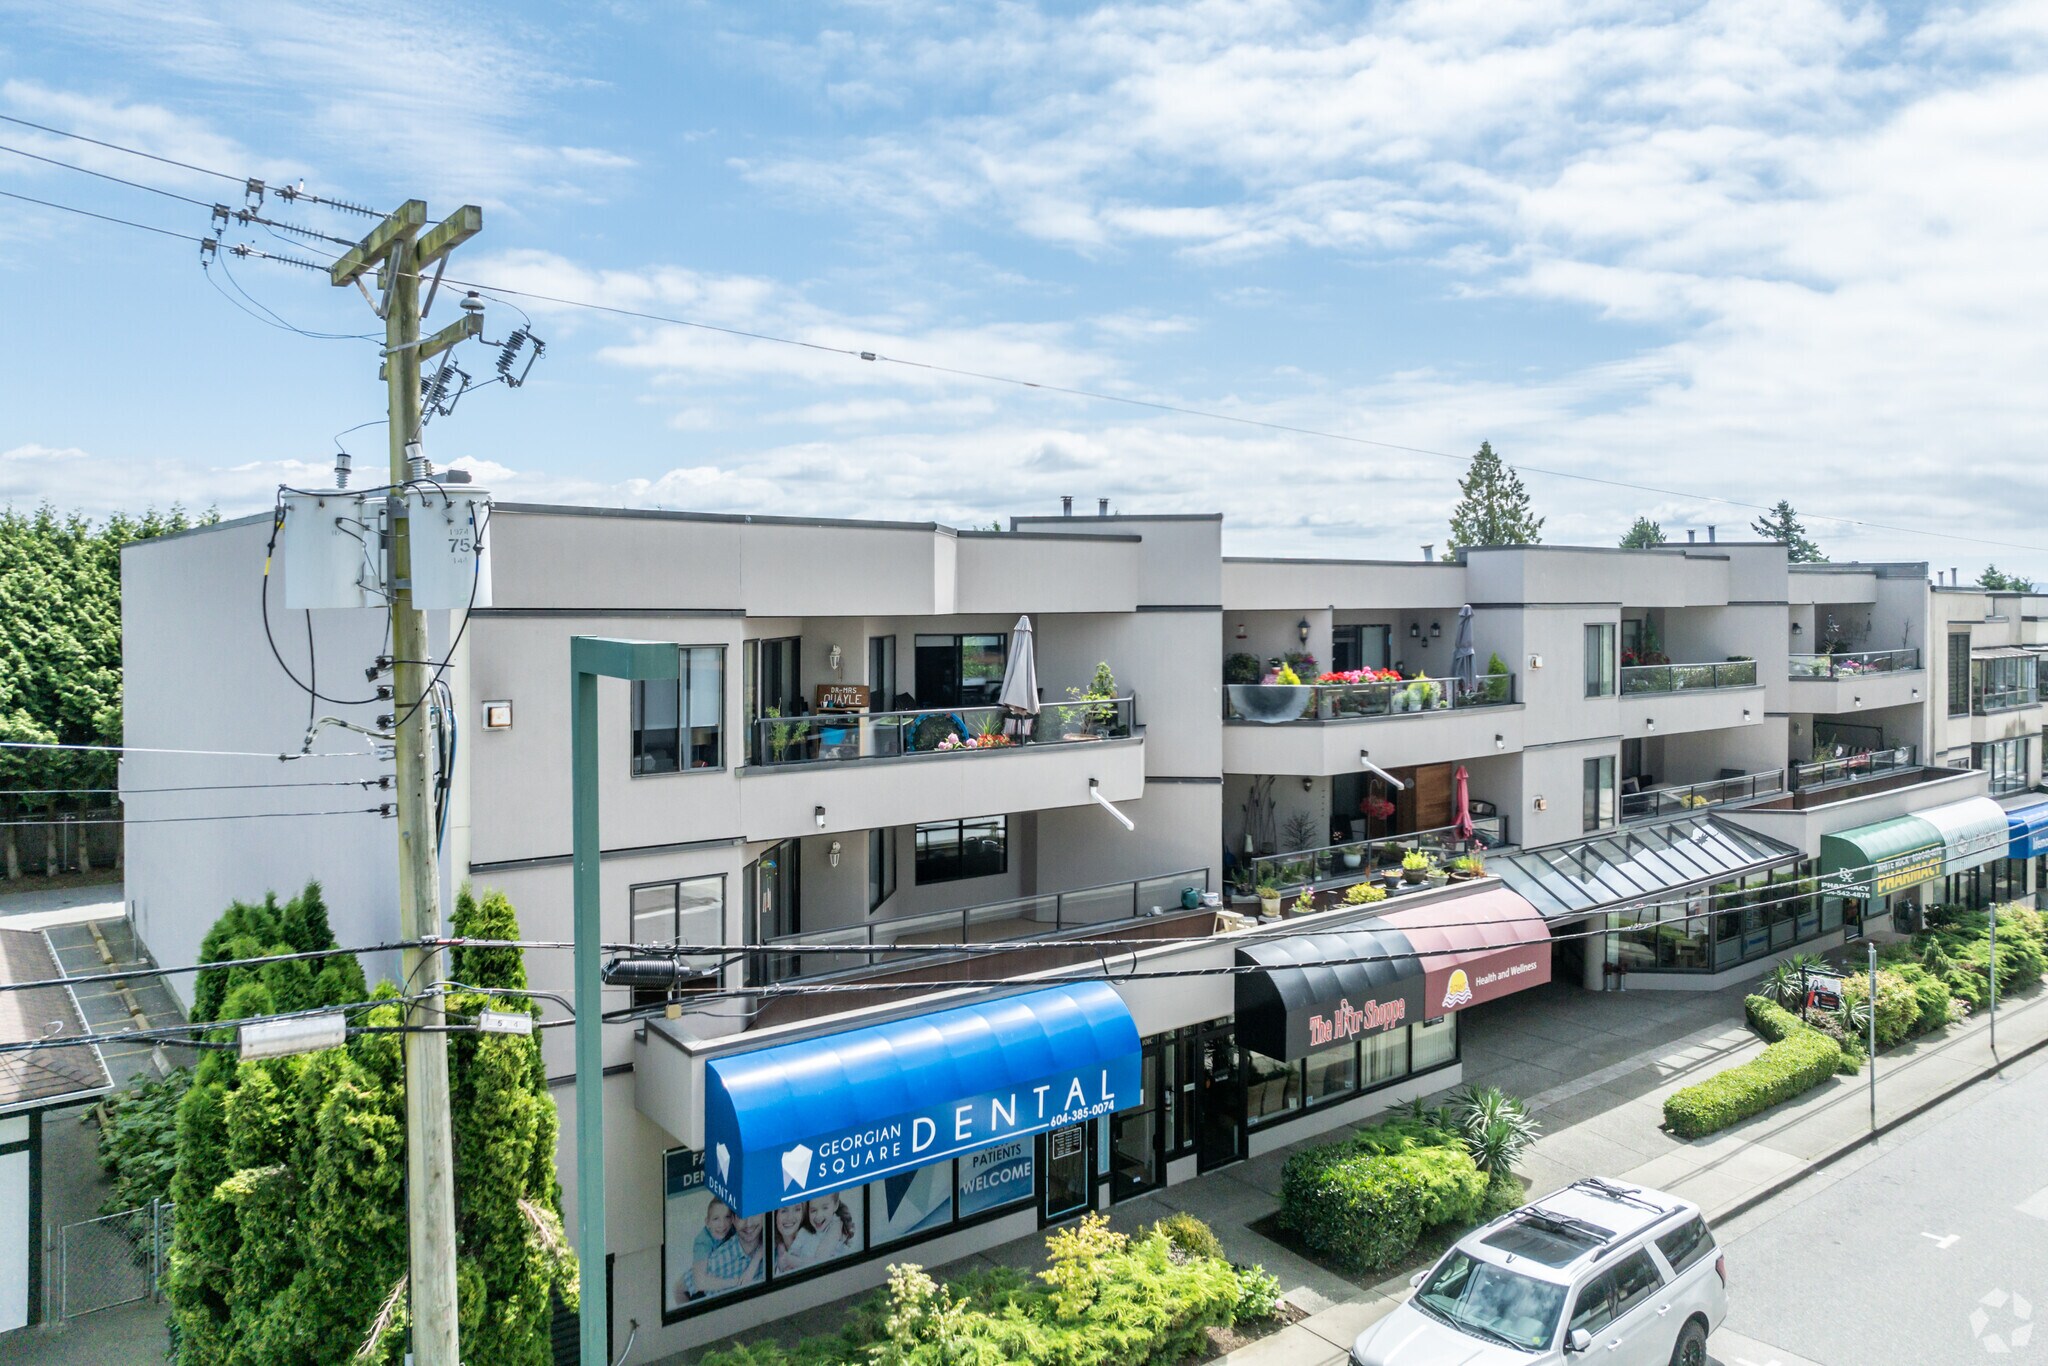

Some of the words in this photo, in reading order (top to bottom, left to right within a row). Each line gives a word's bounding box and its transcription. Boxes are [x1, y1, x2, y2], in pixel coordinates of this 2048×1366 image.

[448, 538, 471, 553] 75
[823, 694, 863, 705] QUAYLE
[1877, 857, 1942, 893] PHARMACY
[1475, 971, 1497, 987] Health
[1497, 967, 1510, 980] and
[1510, 961, 1537, 976] Wellness
[1309, 1014, 1333, 1046] The
[1363, 998, 1406, 1031] Shoppe
[911, 1069, 1115, 1153] DENTAL
[1050, 1100, 1115, 1128] 604-385-0074
[819, 1123, 901, 1158] GEORGIAN
[972, 1143, 1022, 1168] PATIENTS
[818, 1142, 901, 1178] SQUARE
[709, 1175, 738, 1210] DENTAL
[962, 1161, 1032, 1196] WELCOME
